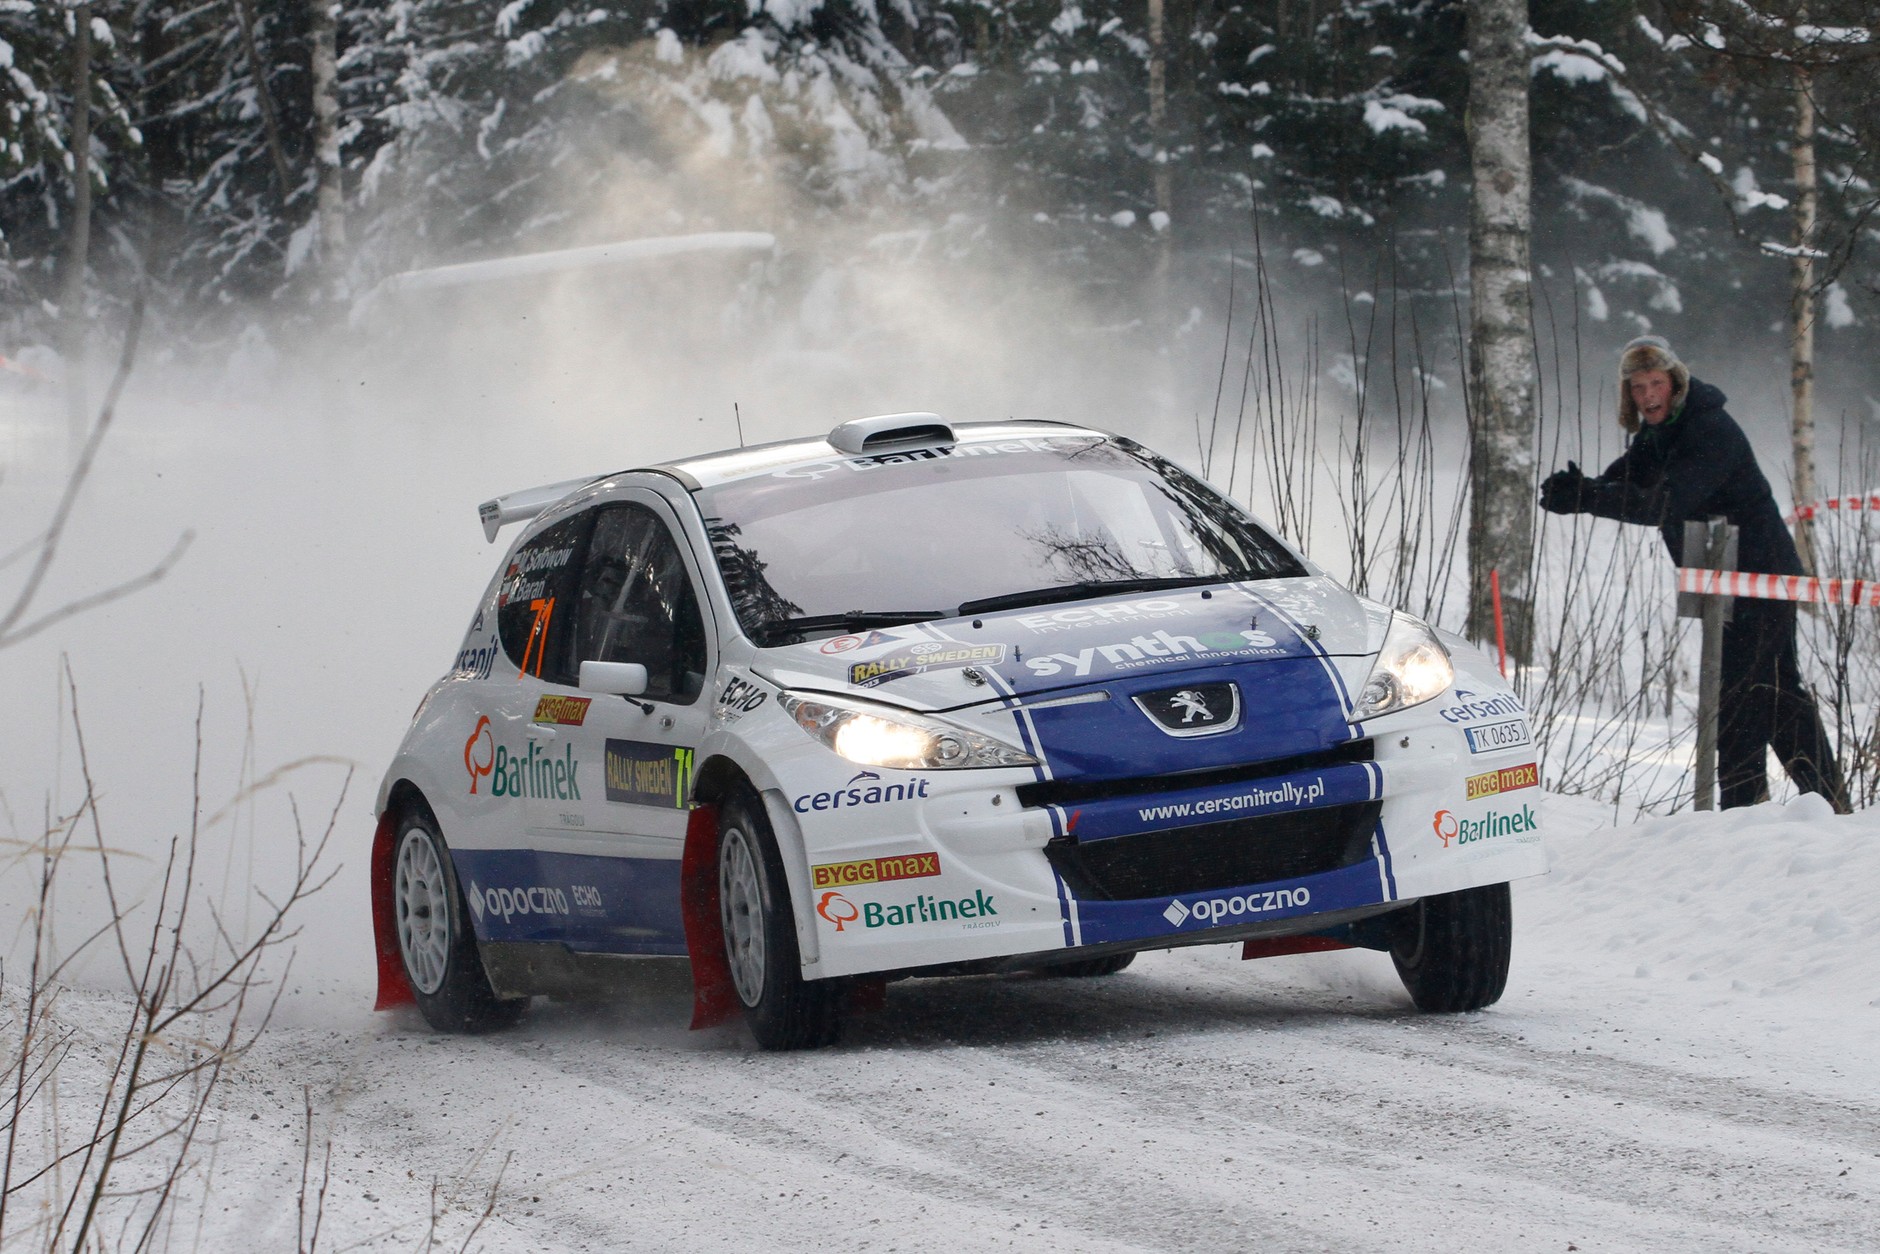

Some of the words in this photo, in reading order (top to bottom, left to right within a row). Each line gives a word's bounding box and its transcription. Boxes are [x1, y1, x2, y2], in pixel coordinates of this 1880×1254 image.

[843, 438, 1056, 472] Barlinek
[1016, 600, 1180, 629] ECHO
[1031, 608, 1194, 634] investment
[517, 597, 556, 679] 71
[1025, 629, 1277, 677] synthos
[854, 657, 911, 683] RALLY
[916, 646, 998, 666] SWEDEN
[1115, 655, 1191, 670] chemical
[1195, 647, 1288, 659] innovations
[719, 676, 768, 712] ECHO
[1439, 692, 1526, 723] cersanit
[1473, 728, 1490, 748] TK
[1491, 723, 1520, 745] 0635
[491, 740, 582, 801] Barlinek
[607, 750, 634, 790] RALLY
[635, 752, 673, 796] SWEDEN
[674, 747, 695, 810] 71
[794, 777, 930, 813] cersanit
[1138, 777, 1325, 822] www.cersanitrally.pl
[1458, 803, 1538, 845] Barlinek
[485, 887, 570, 924] opoczno
[571, 885, 602, 906] ECHO
[863, 889, 998, 928] Barlinek
[1192, 887, 1311, 924] opoczno
